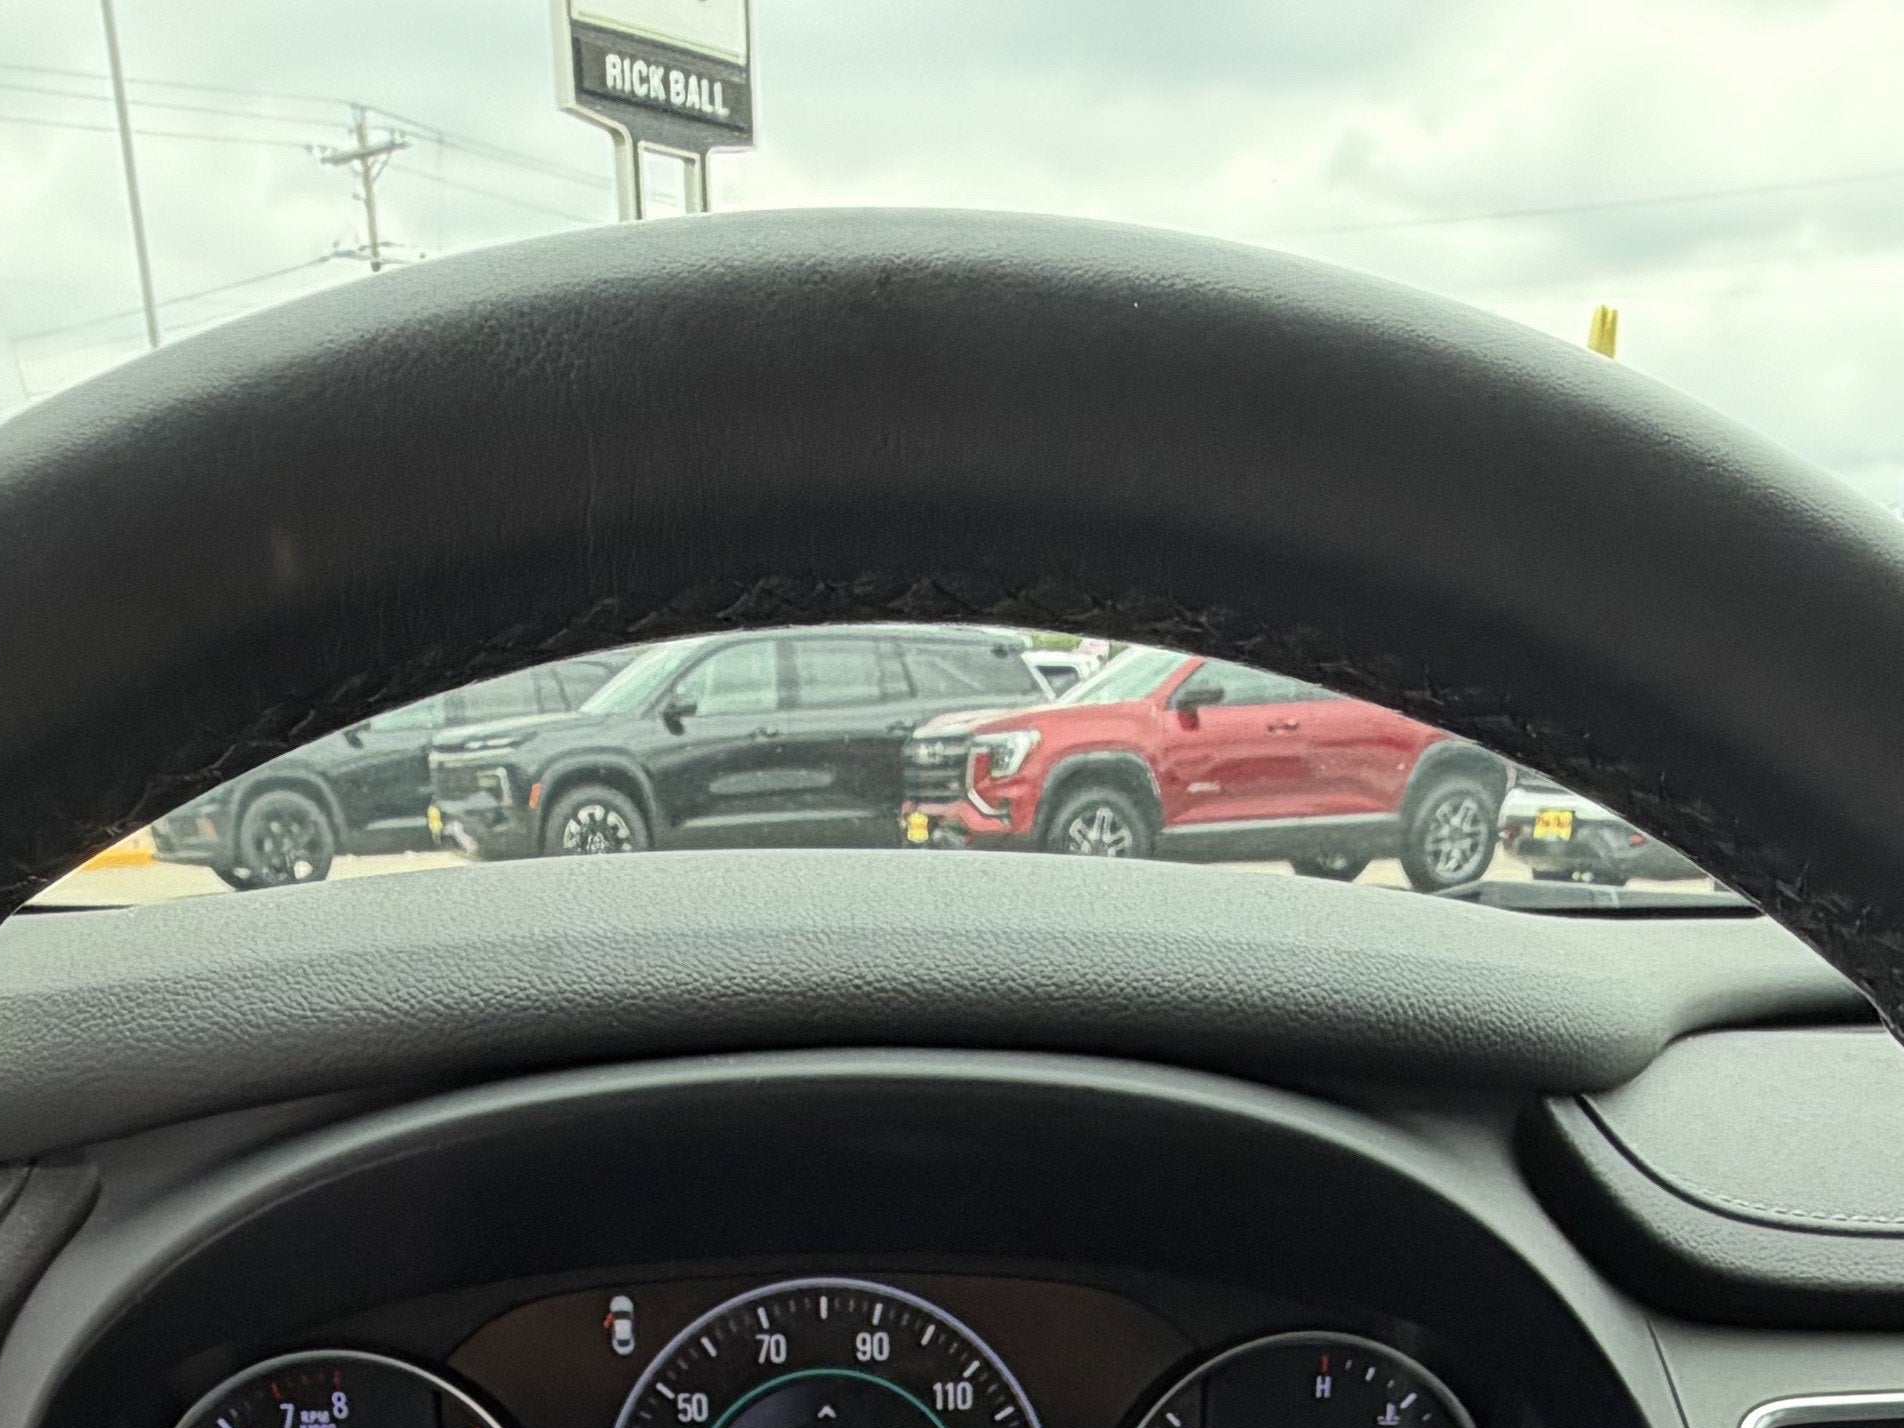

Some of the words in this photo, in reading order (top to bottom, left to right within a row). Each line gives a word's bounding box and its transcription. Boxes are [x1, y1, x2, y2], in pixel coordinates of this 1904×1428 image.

[605, 53, 666, 101] RICK
[669, 69, 730, 118] BALL
[756, 1333, 787, 1364] 70
[856, 1331, 890, 1361] 90
[933, 1380, 973, 1411] 110
[1315, 1376, 1332, 1399] H
[331, 1391, 349, 1419] 8
[677, 1393, 708, 1423] 50
